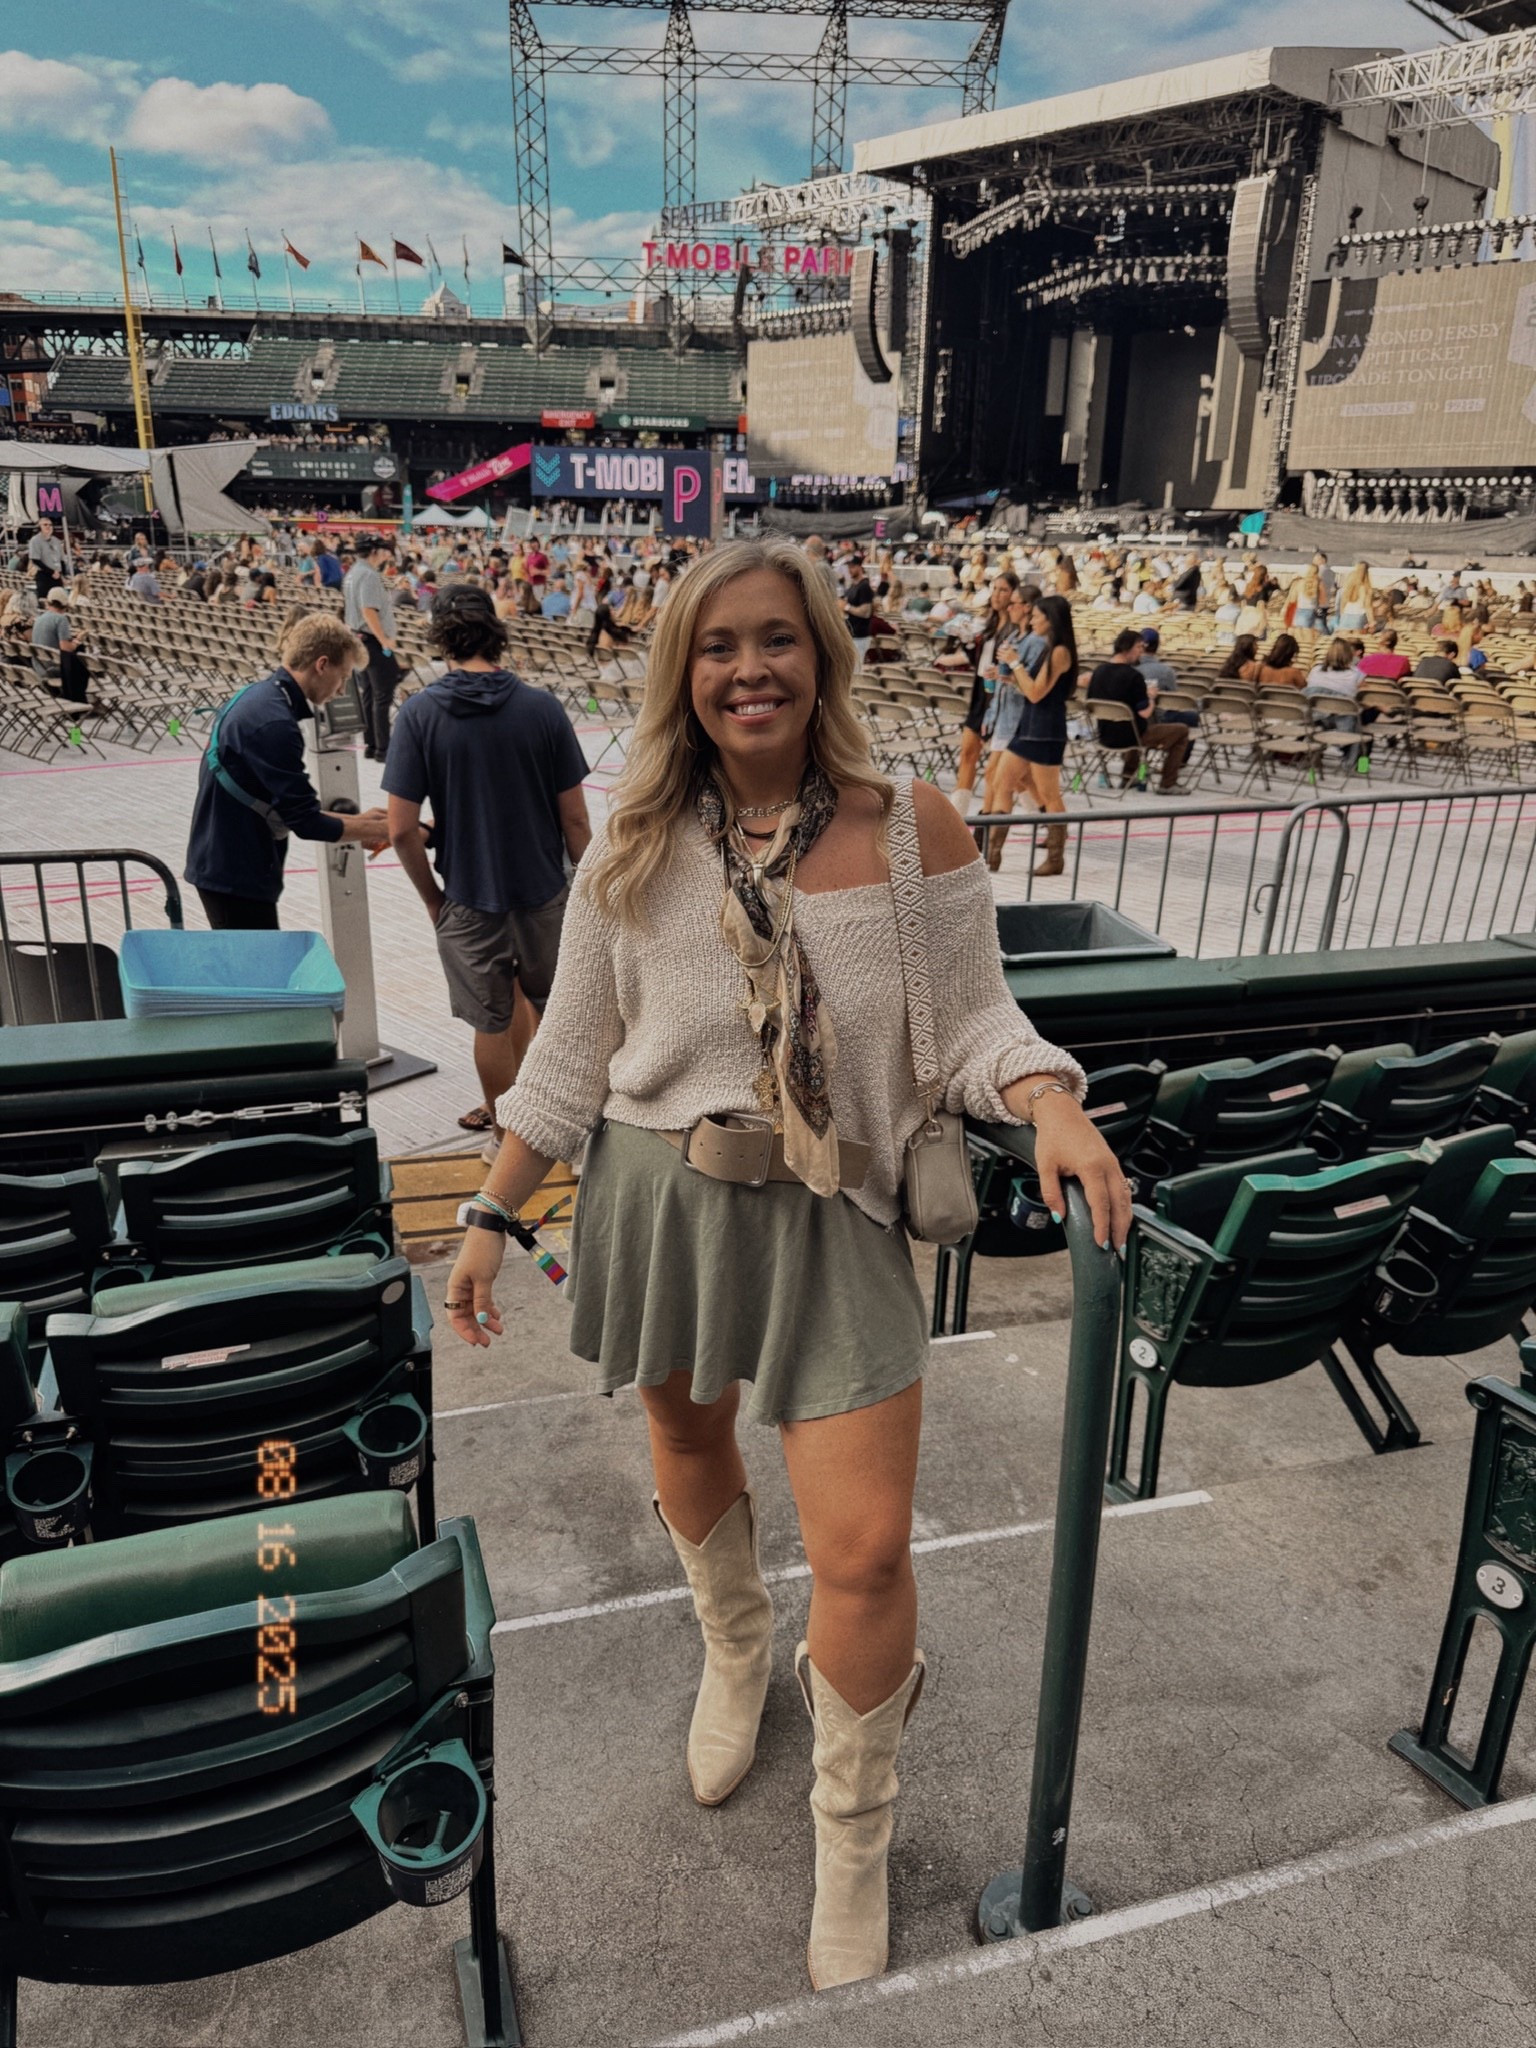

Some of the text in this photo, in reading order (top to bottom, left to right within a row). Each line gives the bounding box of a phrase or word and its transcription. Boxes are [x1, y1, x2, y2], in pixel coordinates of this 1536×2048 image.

[642, 242, 775, 272] T-MOBL
[1348, 334, 1362, 348] A
[1364, 328, 1433, 347] SIGNED
[1436, 322, 1504, 344] JERSEY
[1347, 353, 1361, 367] A
[1365, 350, 1395, 367] PIT
[1398, 345, 1469, 365] TICKET
[1310, 365, 1493, 386] UPGRADE TONIGHT!
[270, 403, 339, 421] EDGARS
[632, 417, 690, 428] STARBUCKS
[570, 454, 665, 491] T-MOBI
[38, 487, 62, 512] M
[673, 465, 701, 523] P
[1138, 1345, 1147, 1360] 2
[1491, 1576, 1506, 1595] 3
